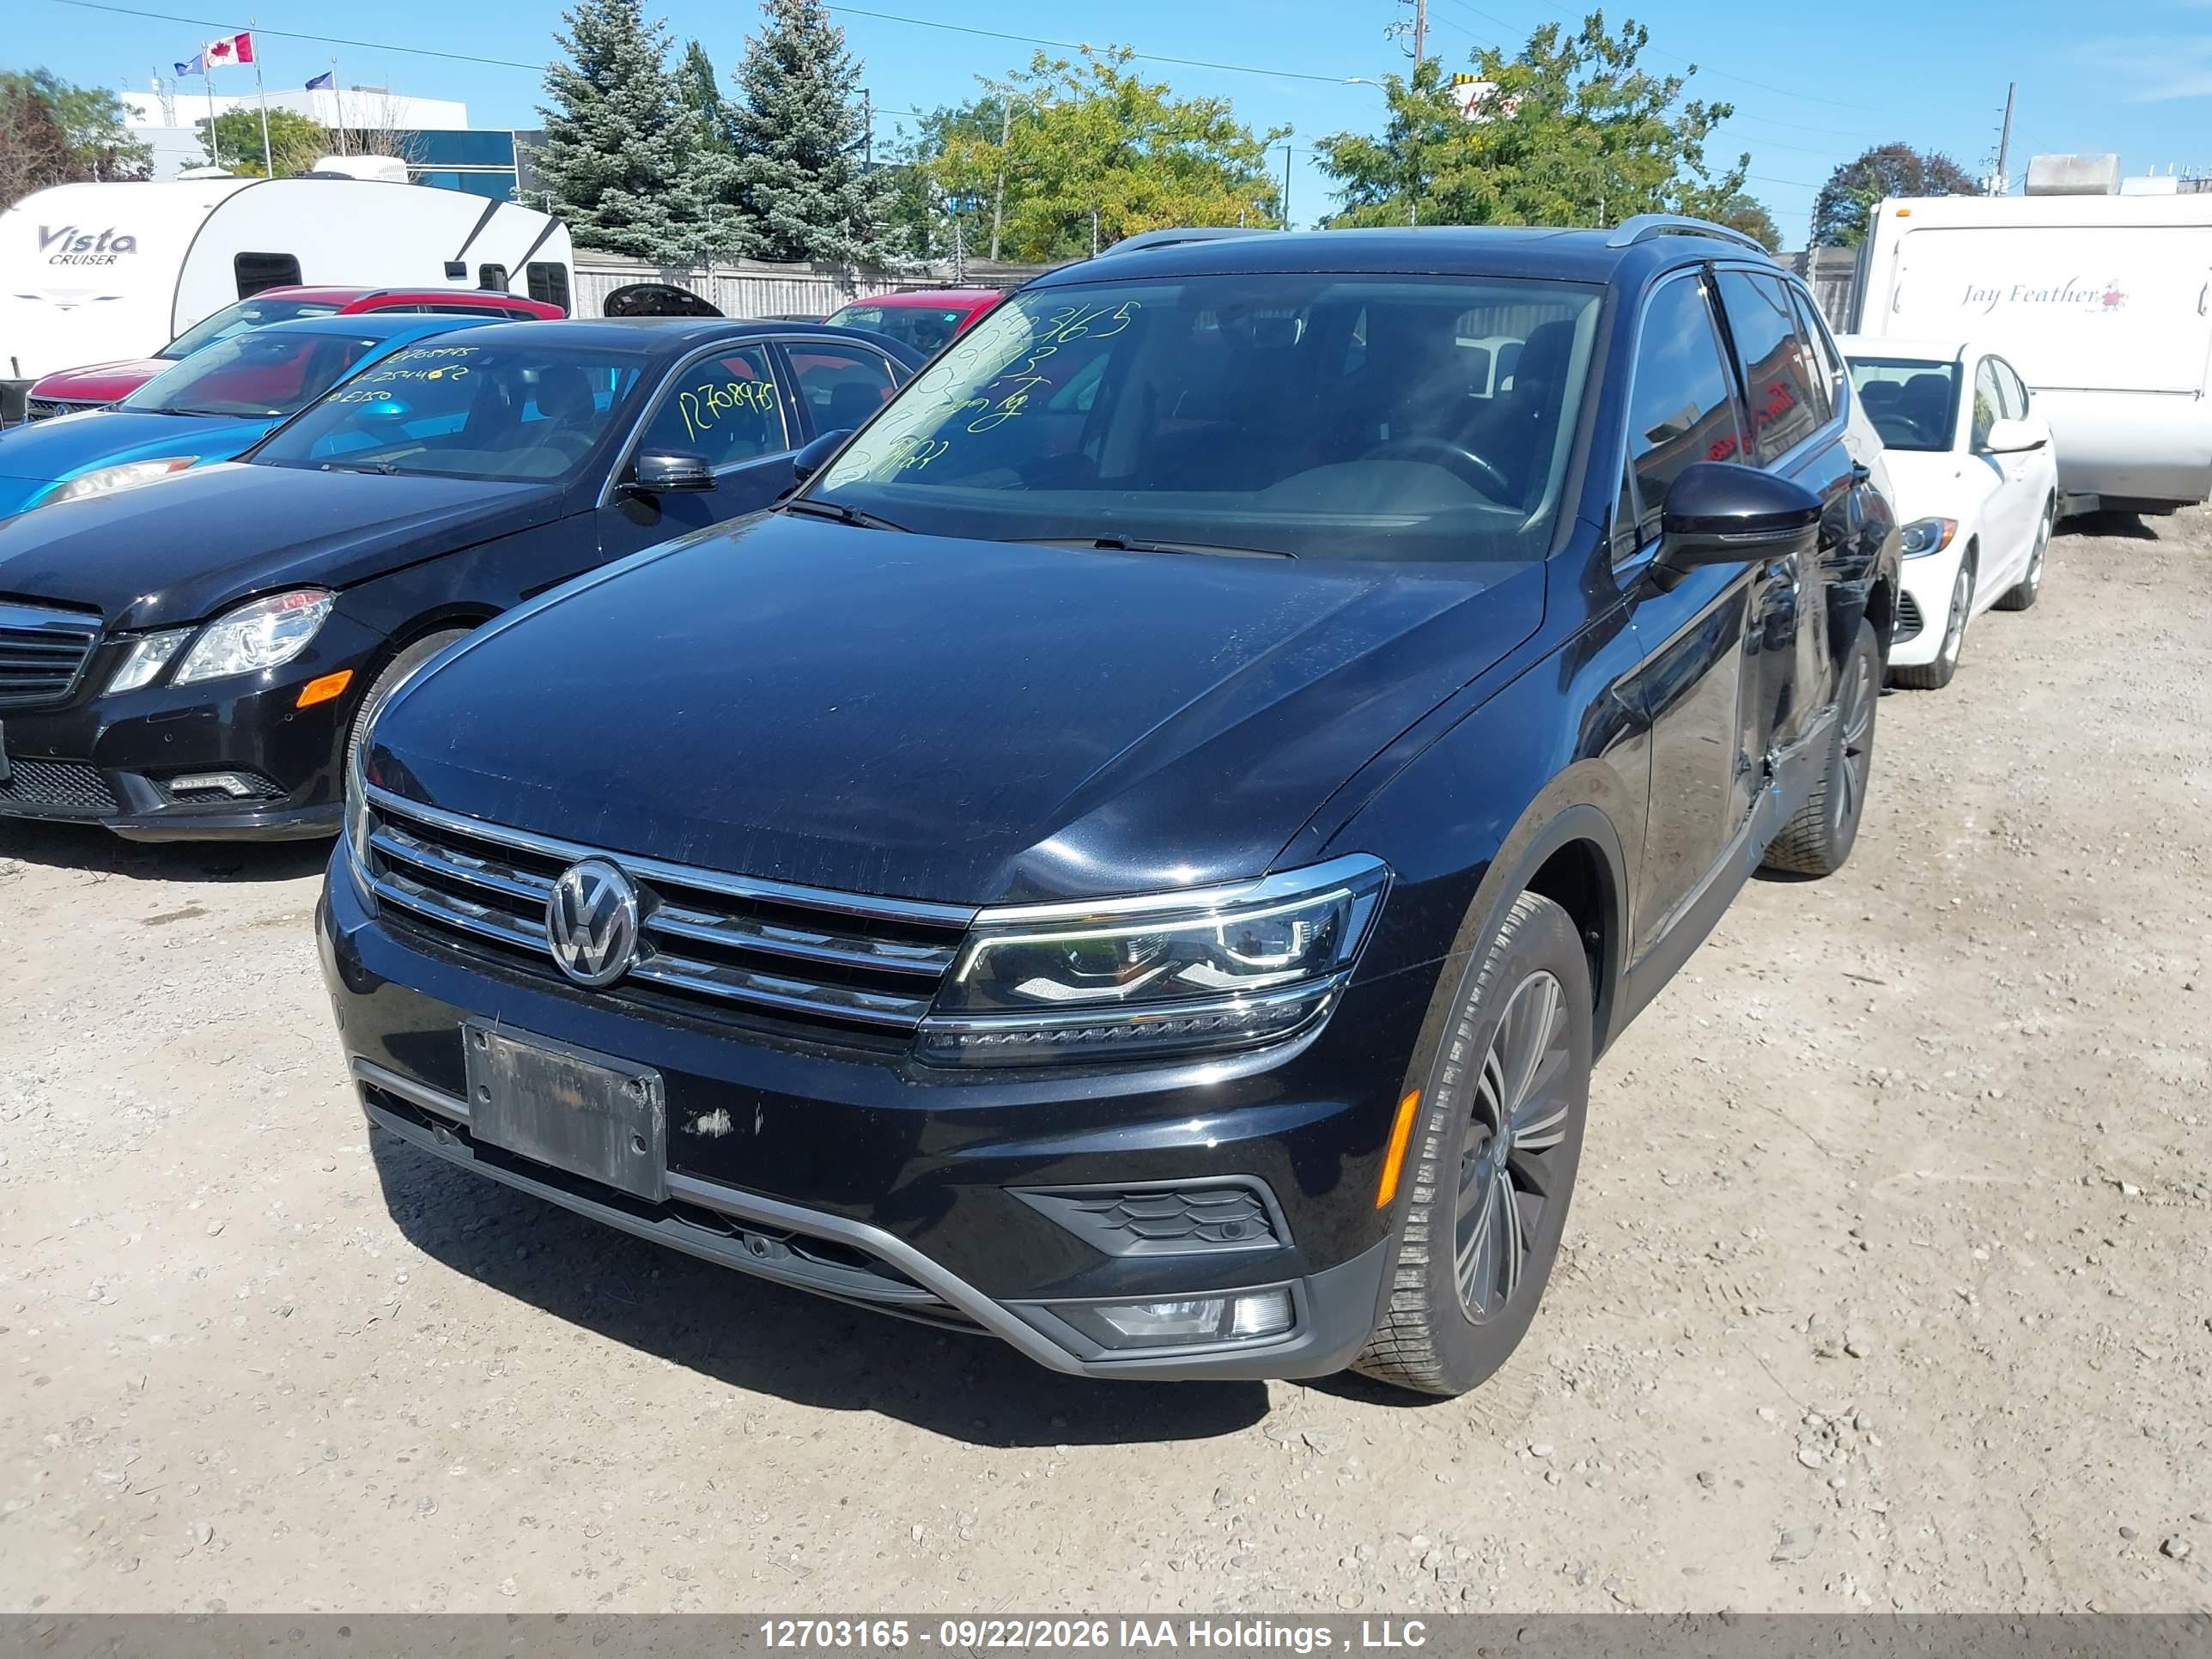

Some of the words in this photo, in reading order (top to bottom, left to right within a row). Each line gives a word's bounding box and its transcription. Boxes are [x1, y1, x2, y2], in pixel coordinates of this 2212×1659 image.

[39, 225, 137, 254] Vista
[49, 254, 118, 266] CRUISER
[1960, 283, 2002, 316] Jay
[2008, 274, 2100, 303] Feather
